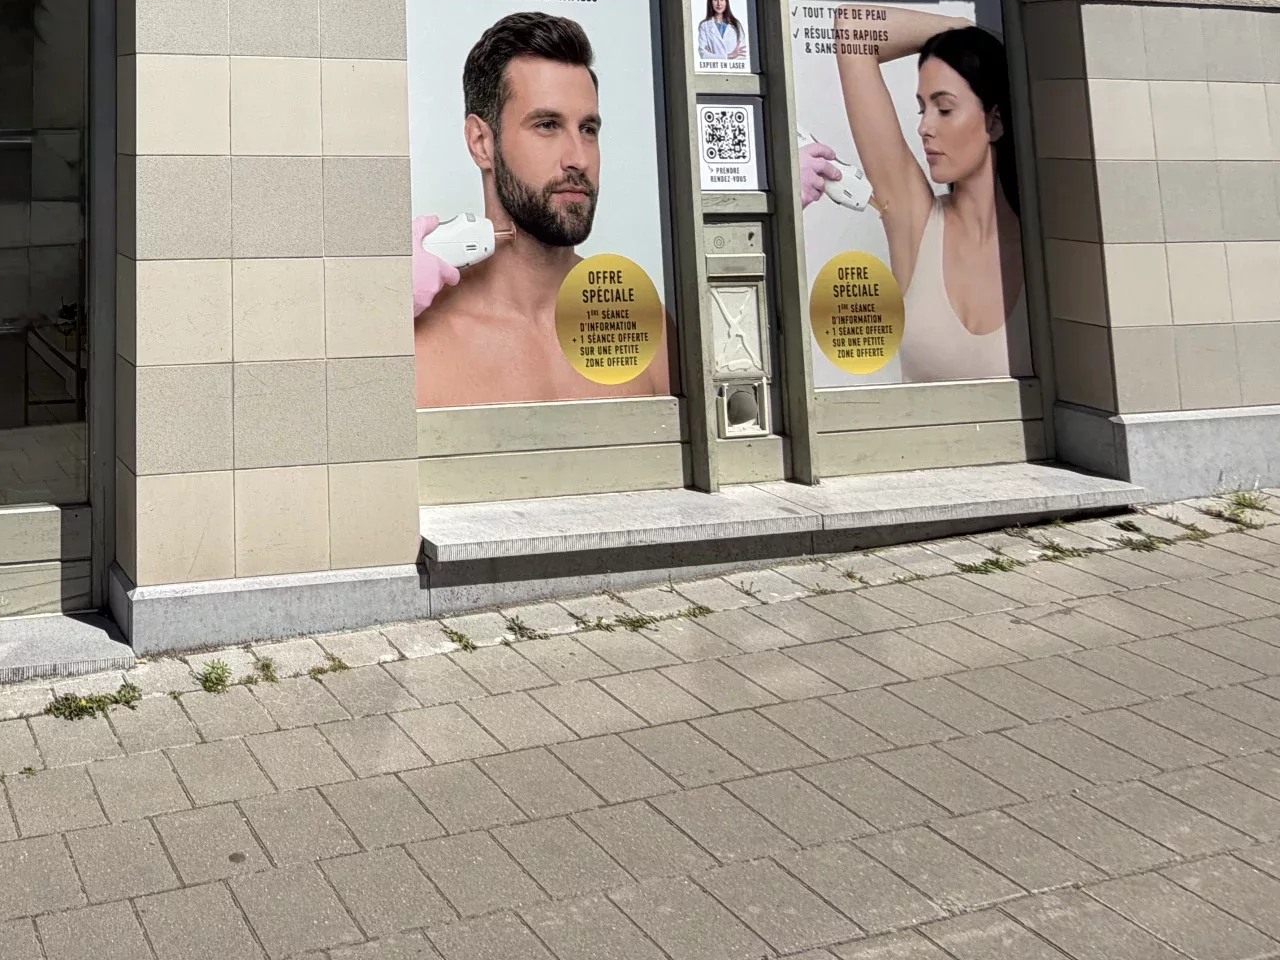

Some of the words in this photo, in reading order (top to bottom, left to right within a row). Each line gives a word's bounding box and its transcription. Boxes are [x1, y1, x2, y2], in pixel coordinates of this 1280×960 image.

[803, 6, 824, 19] TOUT
[828, 8, 849, 20] TYPE
[852, 8, 863, 20] DE
[865, 9, 887, 21] PEAU
[804, 25, 850, 41] RÉSULTATS
[853, 29, 889, 42] RAPIDES
[805, 42, 812, 54] &
[815, 43, 838, 55] SANS
[841, 43, 880, 56] DOULEUR
[699, 61, 719, 69] EXPERT
[720, 61, 728, 69] EN
[729, 61, 746, 70] LASER
[715, 166, 740, 175] PRENDRE
[588, 270, 623, 285] OFFRE
[837, 266, 869, 281] OFFRE
[582, 286, 635, 303] SPÉCIALE
[833, 282, 879, 298] SPÉCIALE
[850, 302, 875, 313] SÉANCE
[601, 308, 630, 320] SÉANCE
[831, 315, 882, 325] D'INFORMATION
[580, 321, 637, 332] D'INFORMATION
[838, 325, 864, 336] SÉANCE
[865, 325, 893, 334] OFFERTE
[587, 332, 616, 344] SÉANCE
[618, 332, 649, 342] OFFERTE
[832, 338, 846, 347] SUR
[848, 338, 861, 347] UNE
[863, 337, 885, 346] PETITE
[580, 346, 595, 356] SUR
[597, 346, 612, 355] UNE
[614, 344, 640, 355] PETITE
[837, 349, 854, 358] ZONE
[856, 348, 884, 357] OFFERTE
[585, 358, 605, 368] ZONE
[607, 356, 638, 367] OFFERTE
